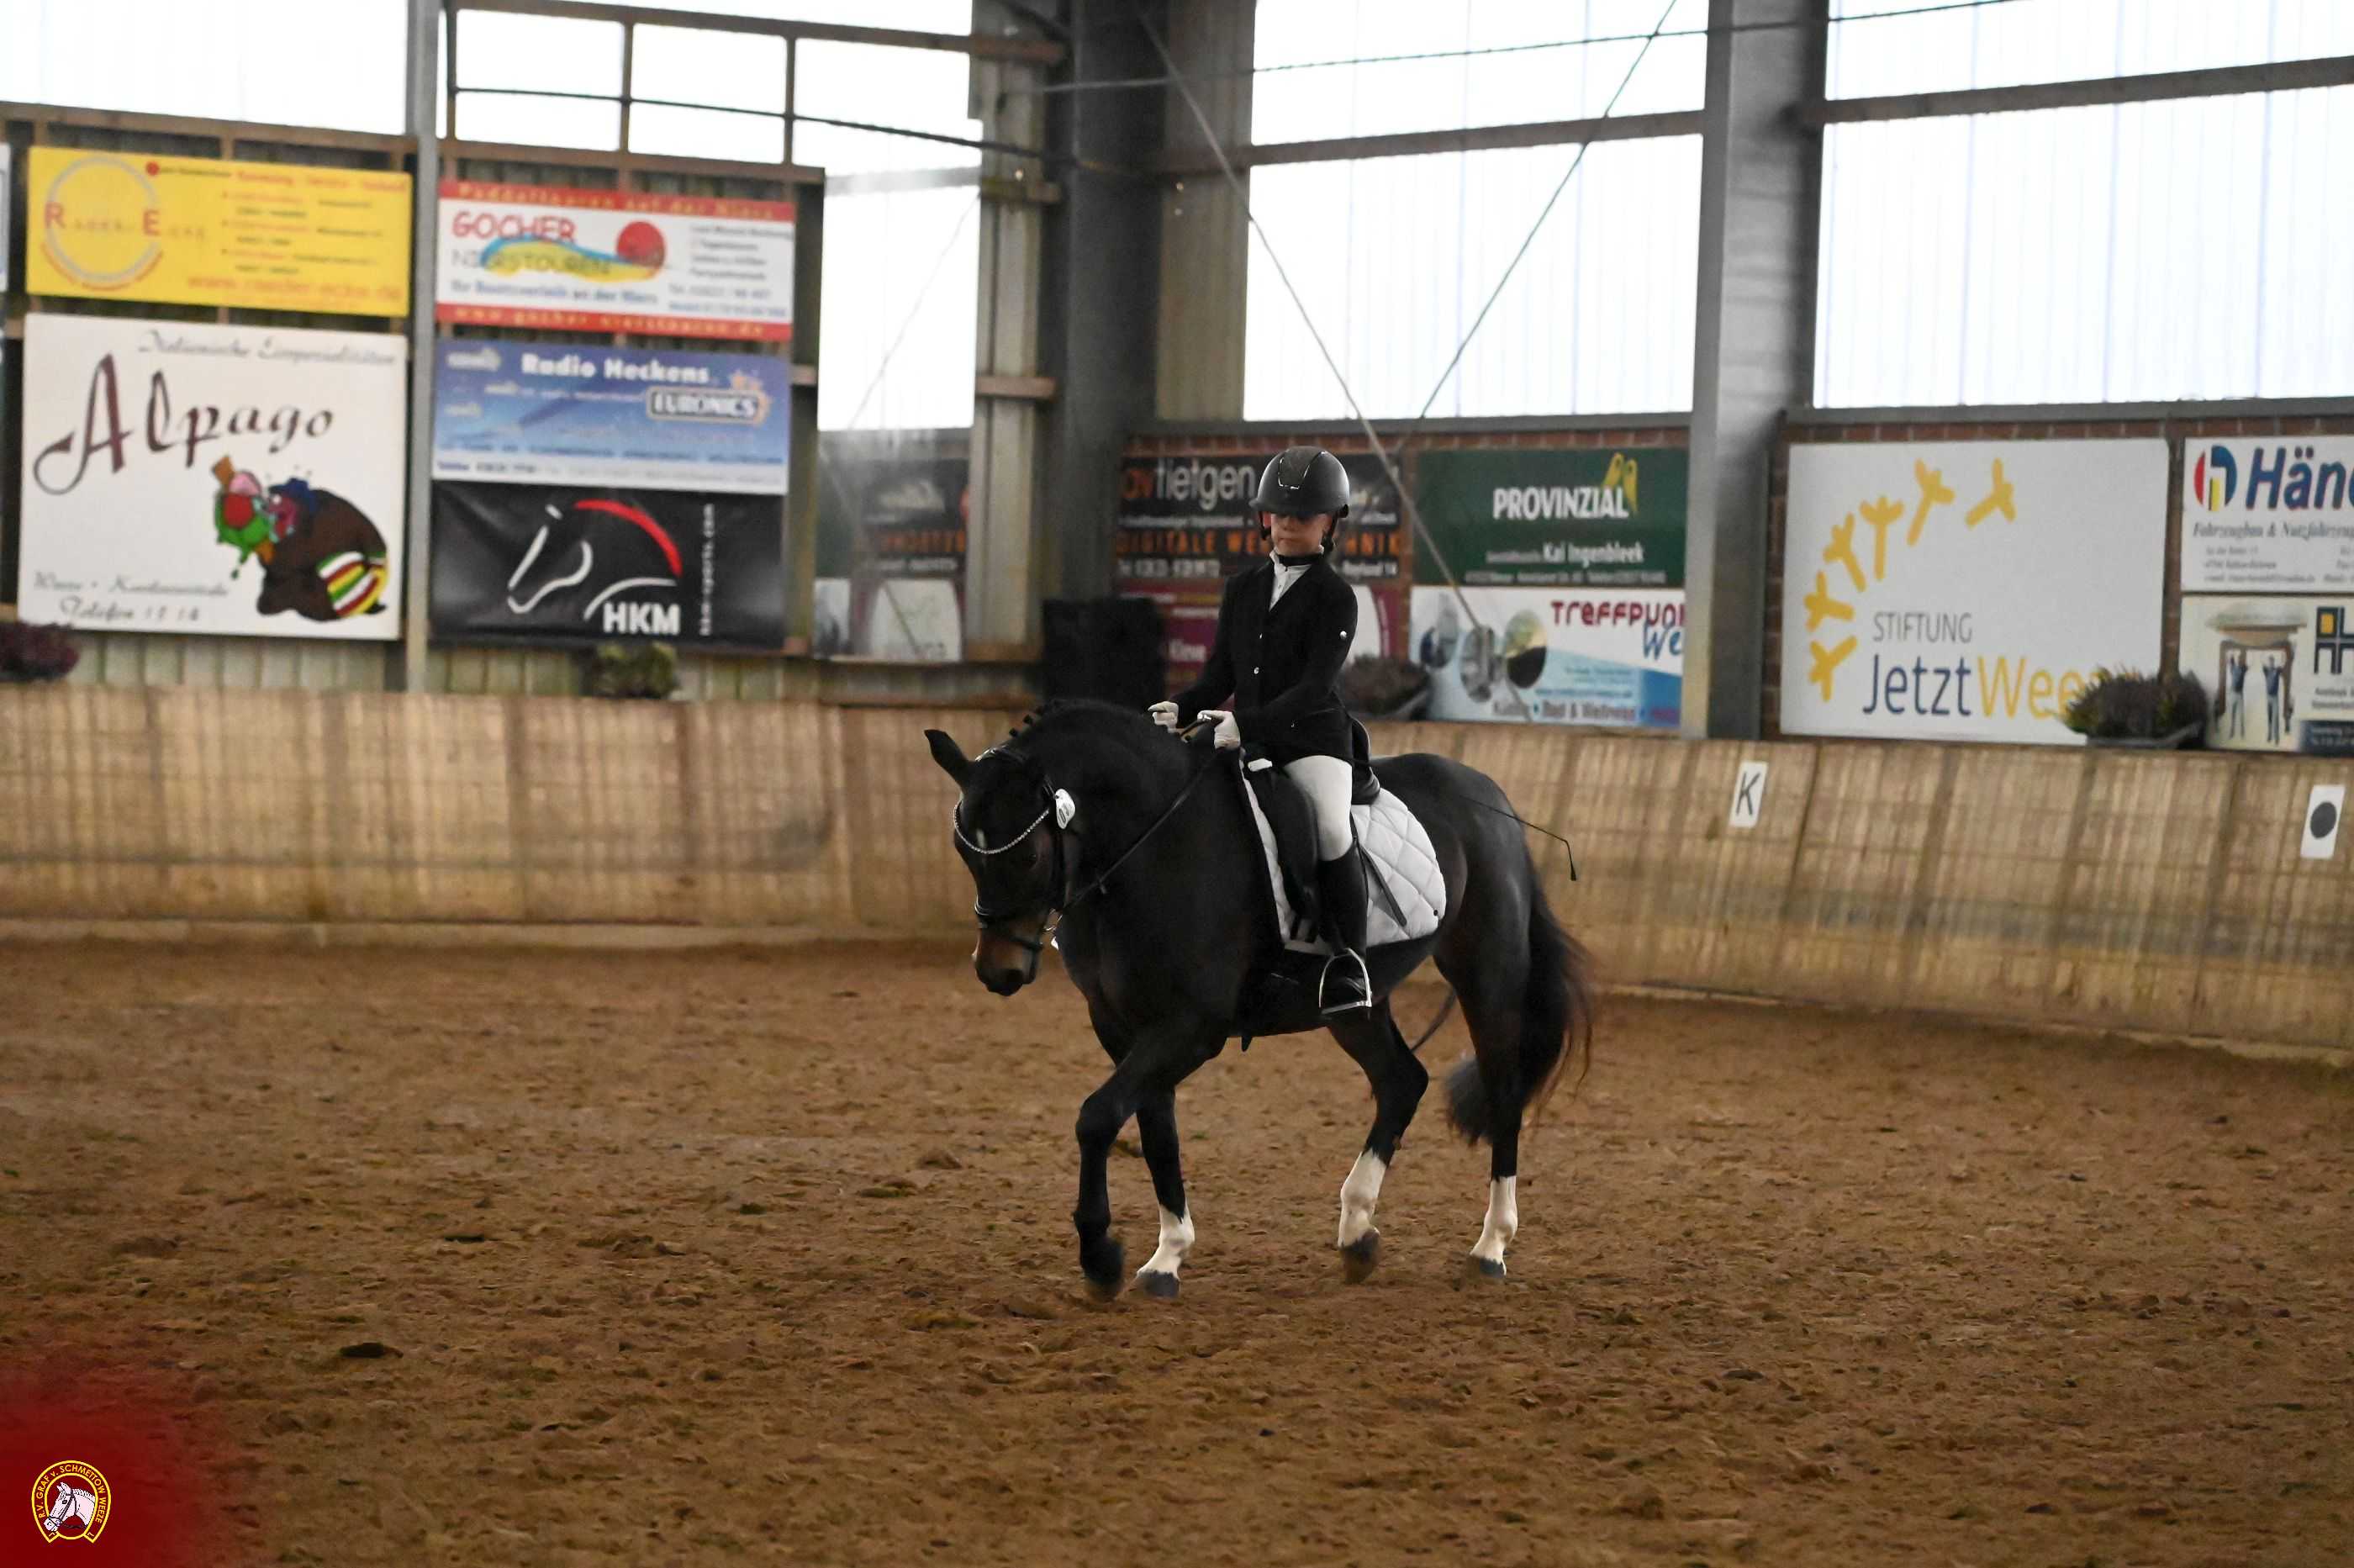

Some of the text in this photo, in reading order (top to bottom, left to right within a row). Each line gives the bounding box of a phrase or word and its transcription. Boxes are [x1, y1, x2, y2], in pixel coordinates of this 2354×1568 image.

[452, 211, 576, 243] GOCHER
[521, 353, 596, 377] Radio
[604, 357, 710, 384] Heckens
[654, 392, 757, 418] EURONICS
[34, 353, 333, 495] Alpago
[2245, 446, 2354, 510] Hän
[1493, 486, 1629, 520] PROVINZIAL
[604, 601, 681, 635] HKM
[1872, 611, 1972, 643] STIFTUNG
[1736, 771, 1761, 816] K
